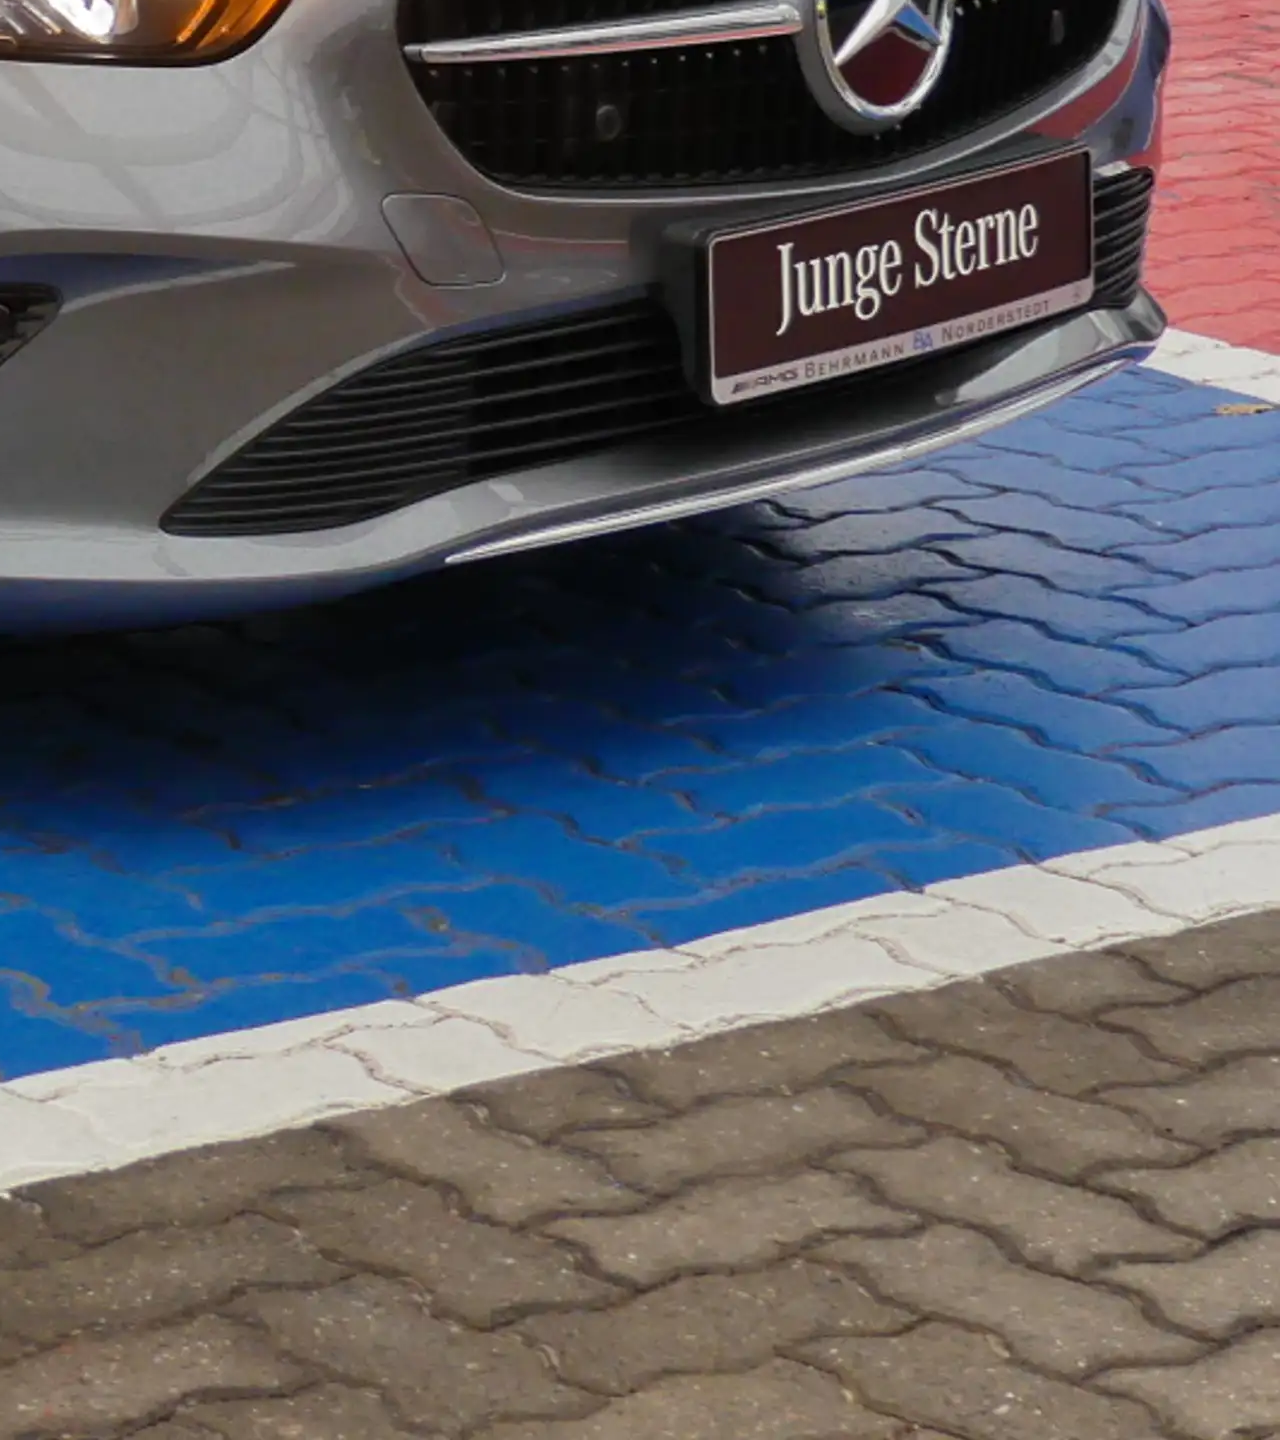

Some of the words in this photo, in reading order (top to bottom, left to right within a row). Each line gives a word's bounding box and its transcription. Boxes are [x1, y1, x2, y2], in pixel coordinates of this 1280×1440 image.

[775, 240, 902, 336] Junge
[914, 203, 1039, 289] Sterne
[804, 343, 905, 379] BEHRMANN
[941, 299, 1051, 342] NORDERSTEDT
